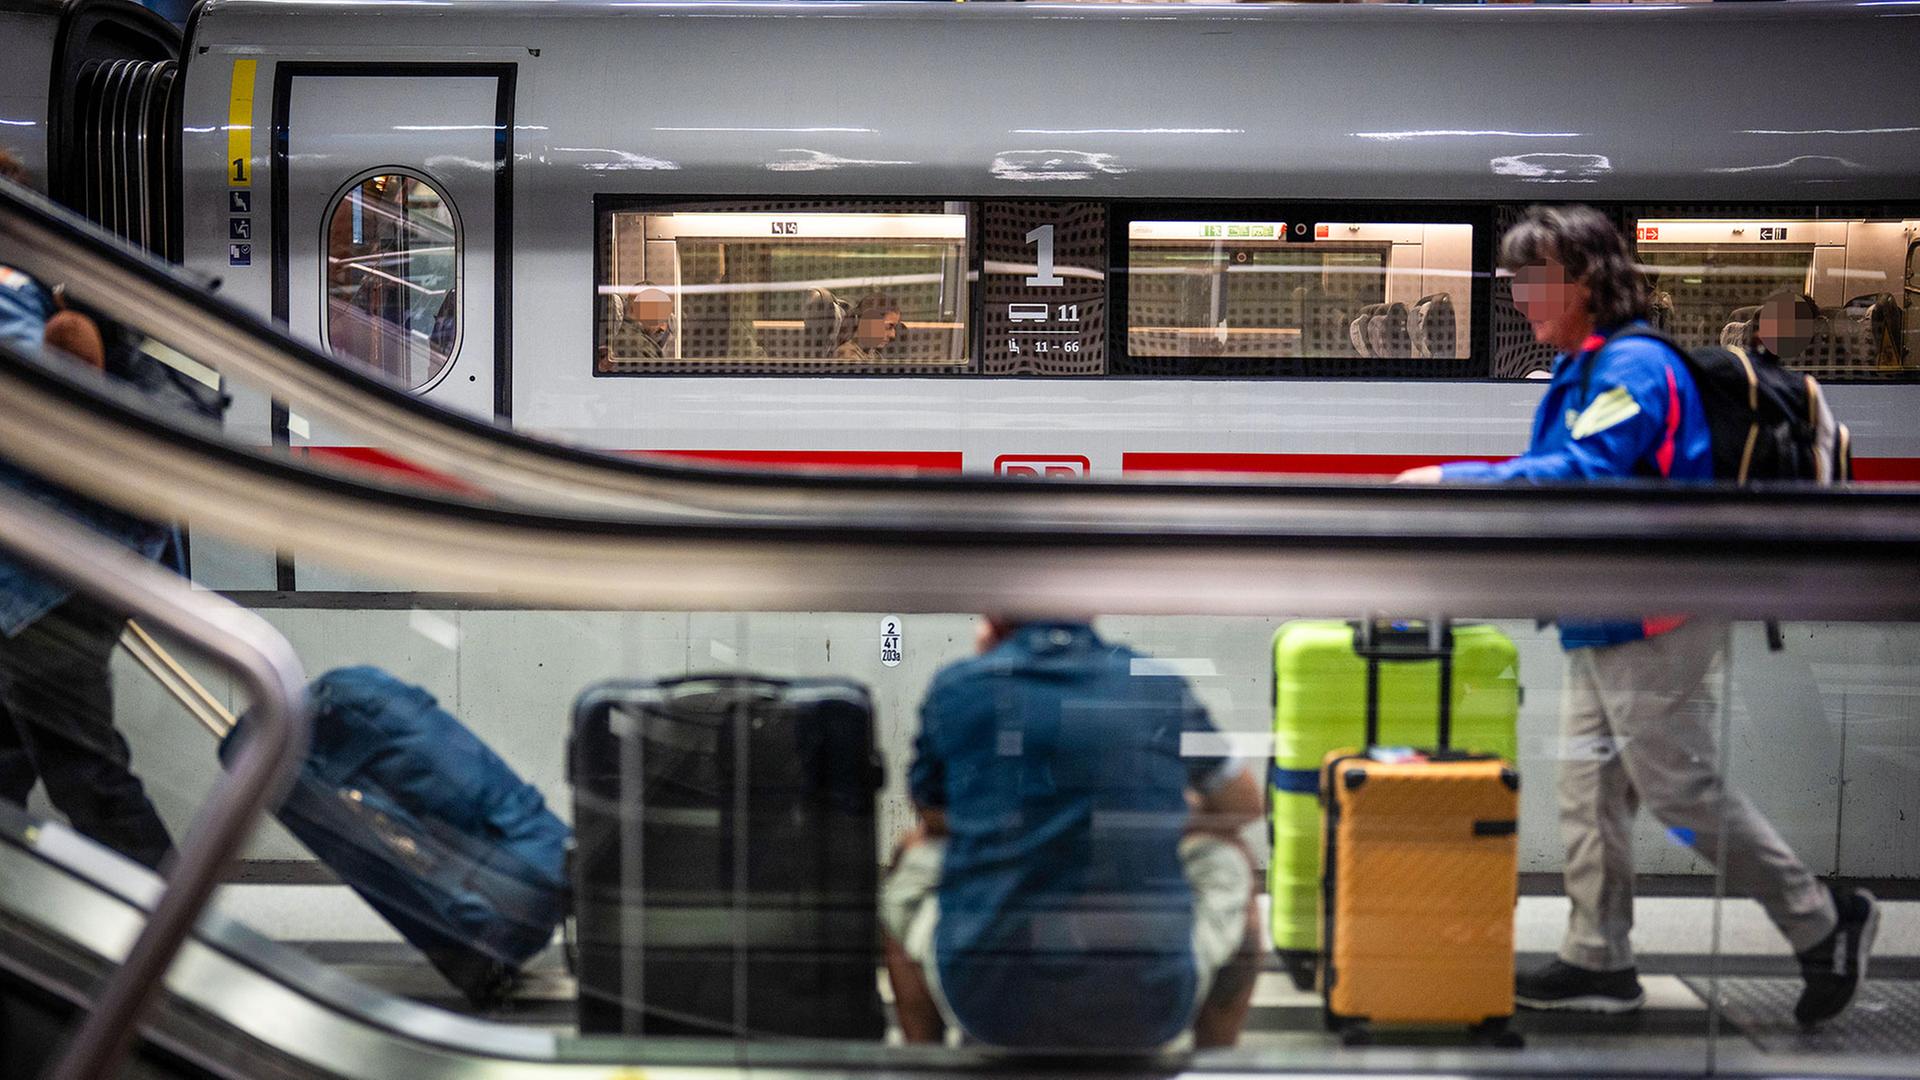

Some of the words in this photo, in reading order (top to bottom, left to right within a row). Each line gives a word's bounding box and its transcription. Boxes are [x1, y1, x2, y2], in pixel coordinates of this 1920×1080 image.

[233, 158, 247, 181] 1
[1026, 224, 1063, 286] 1
[1058, 304, 1079, 322] 11
[1035, 341, 1048, 352] 11
[1064, 341, 1079, 352] 66
[887, 622, 895, 634] 2
